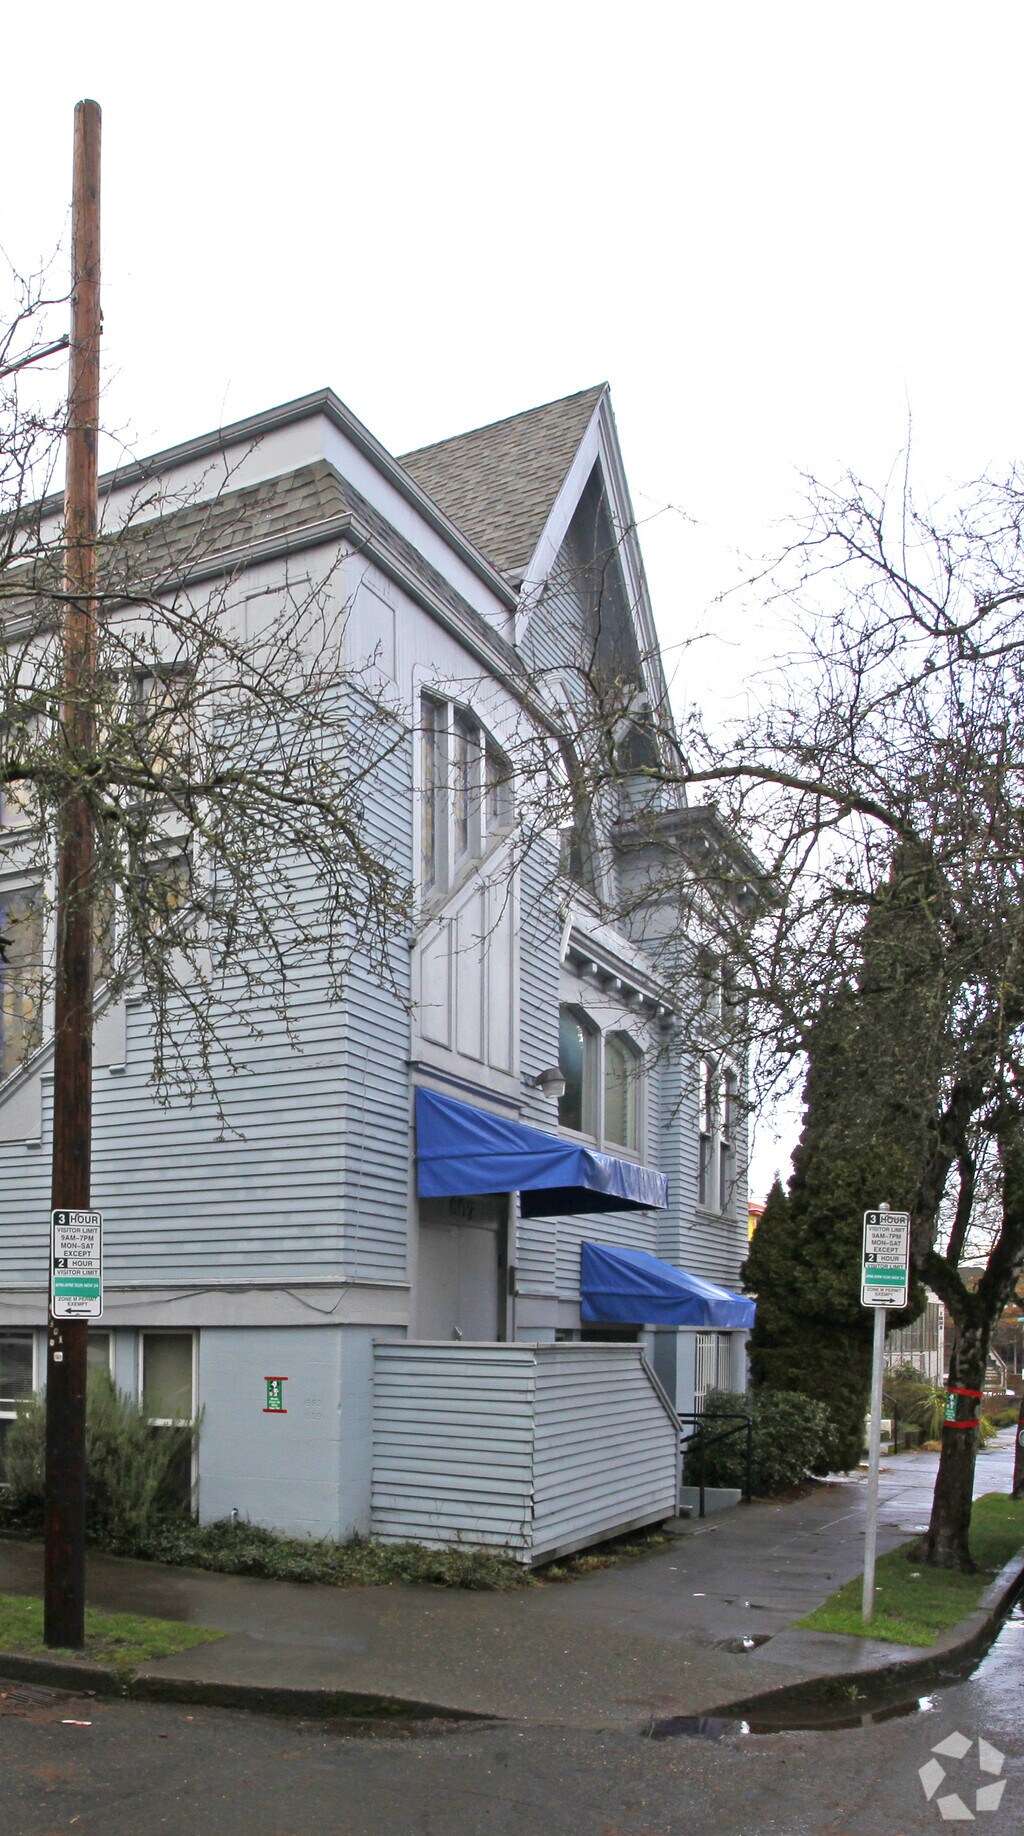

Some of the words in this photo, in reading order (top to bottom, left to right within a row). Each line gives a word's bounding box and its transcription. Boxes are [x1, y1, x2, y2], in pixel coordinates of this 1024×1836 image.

[58, 1214, 66, 1224] 3
[70, 1215, 98, 1224] HOUR
[869, 1214, 877, 1224] 3
[880, 1215, 906, 1224] HOUR
[868, 1253, 874, 1261] 2
[58, 1258, 65, 1267] 2
